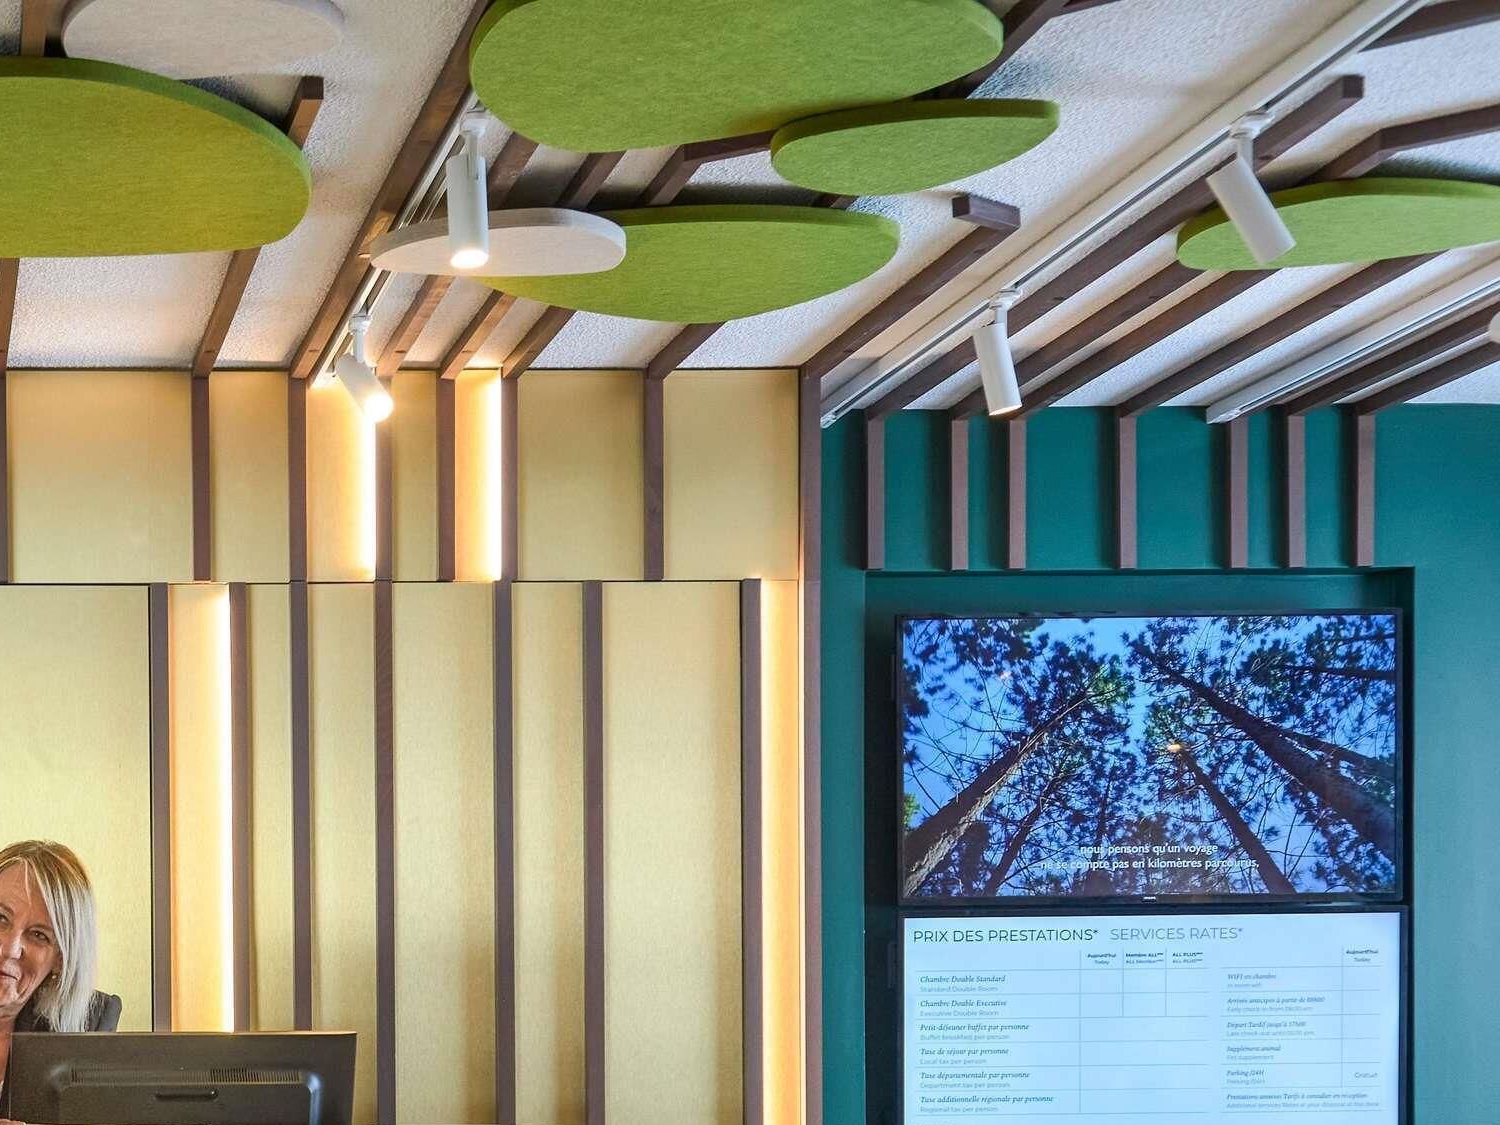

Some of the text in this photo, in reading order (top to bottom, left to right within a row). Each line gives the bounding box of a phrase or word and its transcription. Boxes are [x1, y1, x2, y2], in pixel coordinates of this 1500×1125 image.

[1081, 844, 1218, 856] nous pensons qu'un voyage
[1070, 861, 1110, 871] compte
[1112, 861, 1129, 871] pas
[1132, 861, 1145, 869] en
[1148, 858, 1202, 869] kilomètres
[1204, 859, 1260, 870] parcourus,
[913, 930, 949, 943] PRIX
[953, 930, 984, 942] DES
[1109, 928, 1186, 941] SERVICES
[920, 975, 1006, 983] Chambre Double Standard
[920, 1000, 949, 1008] Chambre
[951, 1000, 975, 1008] Double
[967, 1023, 987, 1032] buffet
[1000, 1023, 1030, 1032] personne
[980, 1048, 1009, 1056] personne
[1001, 1072, 1030, 1080] personne
[1025, 1096, 1054, 1104] personne
